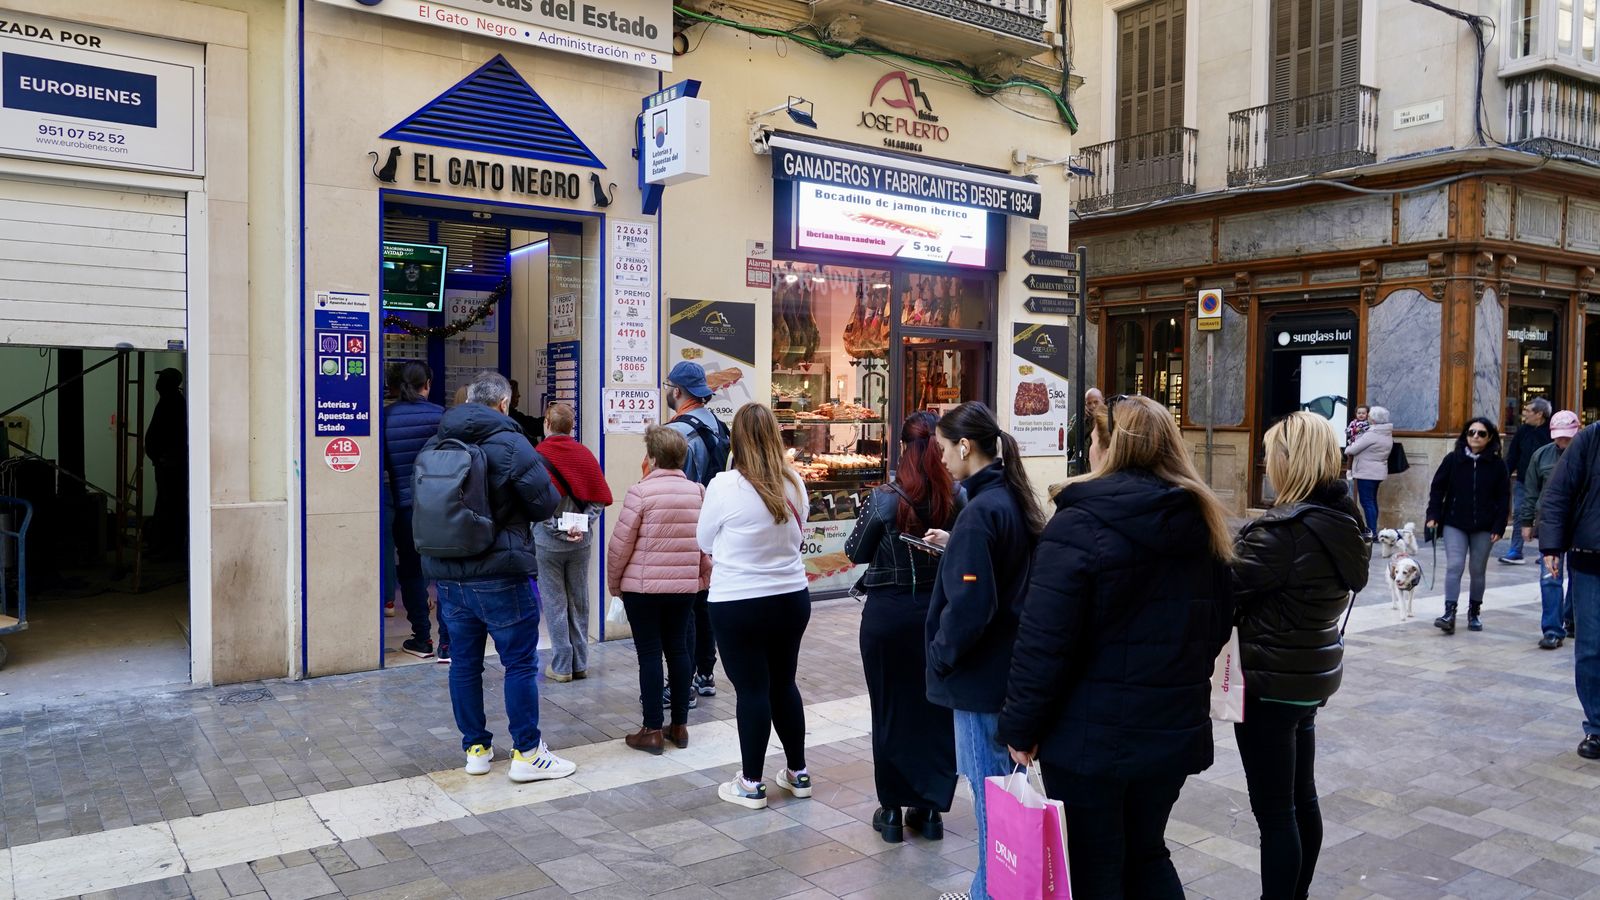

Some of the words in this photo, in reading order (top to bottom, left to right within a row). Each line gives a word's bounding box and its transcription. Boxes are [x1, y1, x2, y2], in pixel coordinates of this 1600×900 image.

[540, 0, 575, 21] del
[583, 4, 658, 40] Estado
[60, 30, 102, 48] POR
[419, 5, 431, 19] El
[435, 8, 470, 27] Gato
[476, 18, 517, 37] Negro
[538, 31, 629, 60] Administración
[650, 54, 657, 64] 5
[20, 76, 142, 106] EUROBIENES
[857, 111, 893, 133] JOSE
[896, 117, 949, 142] PUERTO
[38, 124, 63, 137] 951
[67, 128, 84, 139] 07
[88, 130, 105, 143] 52
[108, 133, 125, 145] 52
[36, 136, 128, 154] www.eurobienes.com
[883, 138, 922, 152] SALAMANCA
[671, 152, 679, 161] del
[413, 152, 441, 183] EL
[448, 157, 504, 191] GATO
[511, 164, 580, 200] NEGRO
[652, 167, 666, 175] Estado
[784, 152, 870, 188] GANADEROS
[872, 168, 881, 189] Y
[885, 170, 967, 203] FABRICANTES
[970, 185, 1007, 210] DESDE
[1009, 191, 1033, 214] 1954
[815, 189, 871, 206] Bocadillo
[875, 199, 889, 208] de
[893, 200, 927, 214] jamon
[616, 226, 648, 235] 22654
[806, 230, 833, 240] Iberian
[834, 232, 850, 241] ham
[851, 234, 886, 246] sandwich
[616, 262, 648, 272] 08602
[452, 305, 475, 313] 086
[554, 303, 573, 315] 14323
[618, 298, 646, 306] 04211
[618, 329, 646, 338] 41710
[1293, 330, 1334, 345] sunglass
[1335, 329, 1351, 340] hut
[1507, 328, 1536, 343] sunglass
[620, 363, 645, 371] 18065
[318, 400, 351, 408] Loterías
[352, 402, 357, 410] y
[610, 399, 655, 409] 14323
[318, 412, 354, 421] Apuestas
[356, 412, 369, 420] del
[332, 441, 352, 452] +18
[1221, 654, 1231, 692] druni.es
[995, 840, 1017, 868] DRUNI
